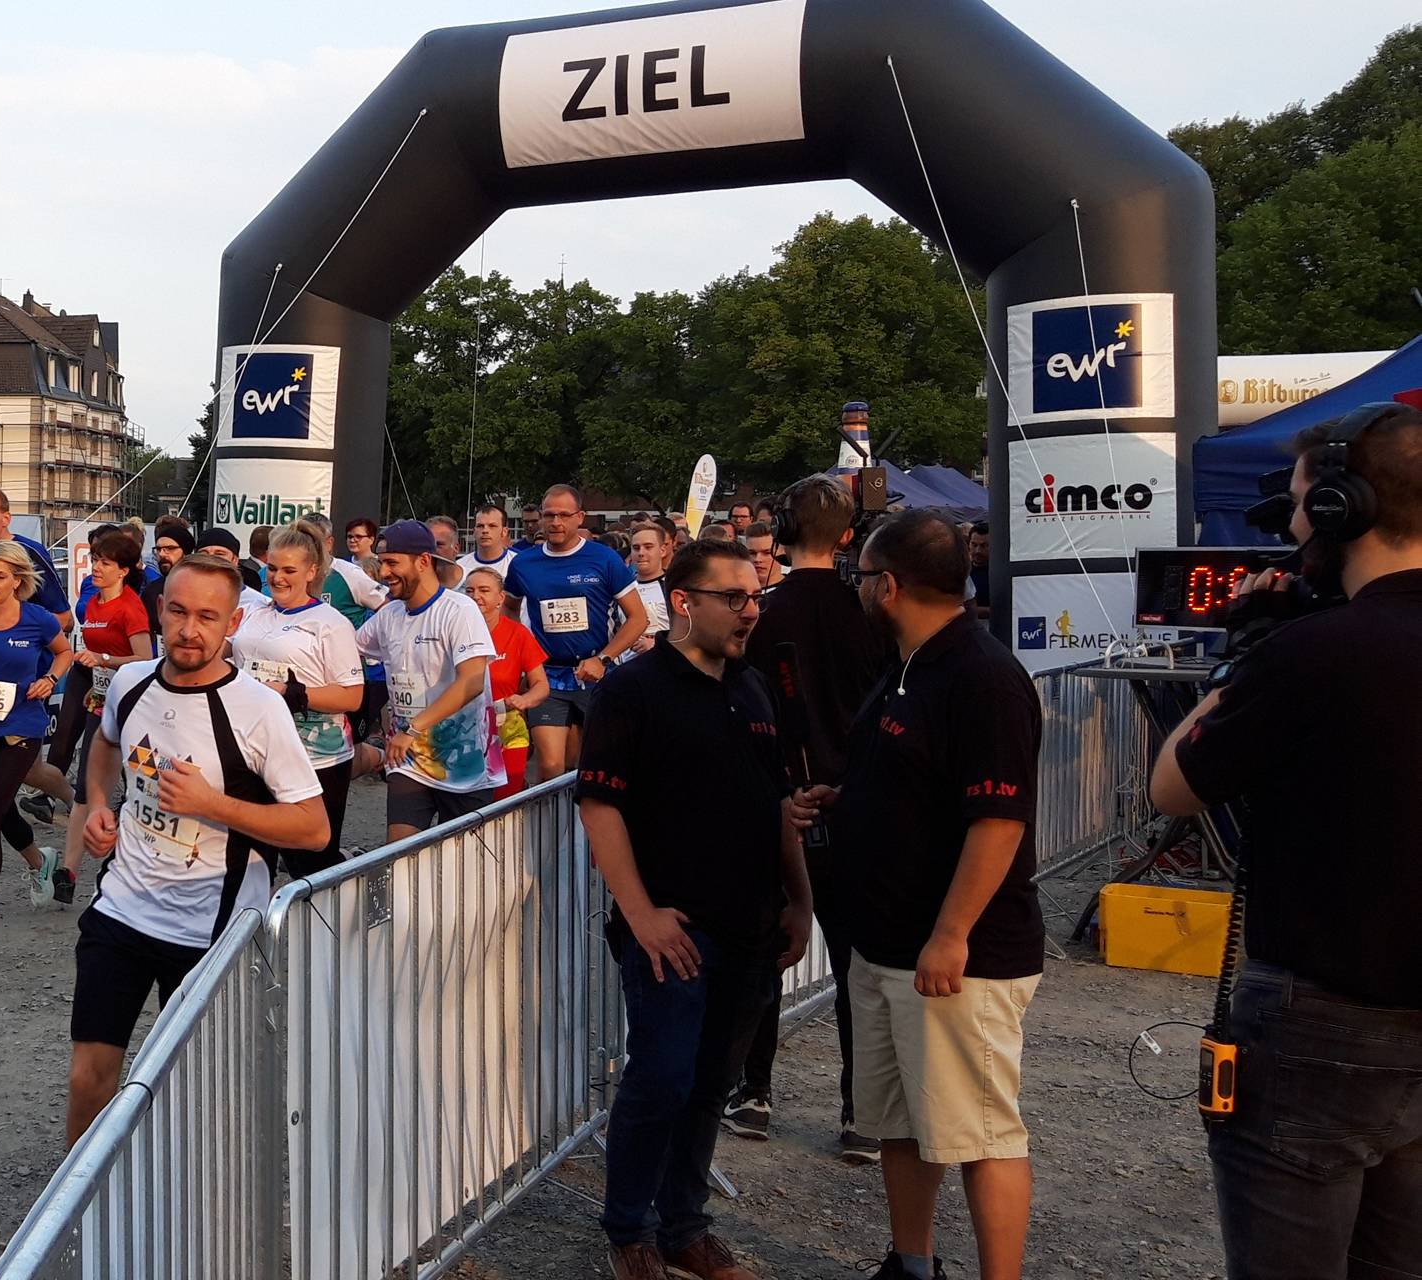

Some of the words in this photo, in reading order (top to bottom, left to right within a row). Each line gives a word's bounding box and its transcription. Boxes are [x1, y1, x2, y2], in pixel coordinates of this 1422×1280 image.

[562, 44, 730, 122] ZIEL
[1047, 341, 1126, 382] ewr
[242, 384, 299, 415] ewr
[231, 494, 325, 525] Vaillant
[1025, 474, 1153, 513] cimco
[549, 612, 580, 624] 1283
[1021, 628, 1043, 640] ewr
[134, 800, 180, 838] 1551
